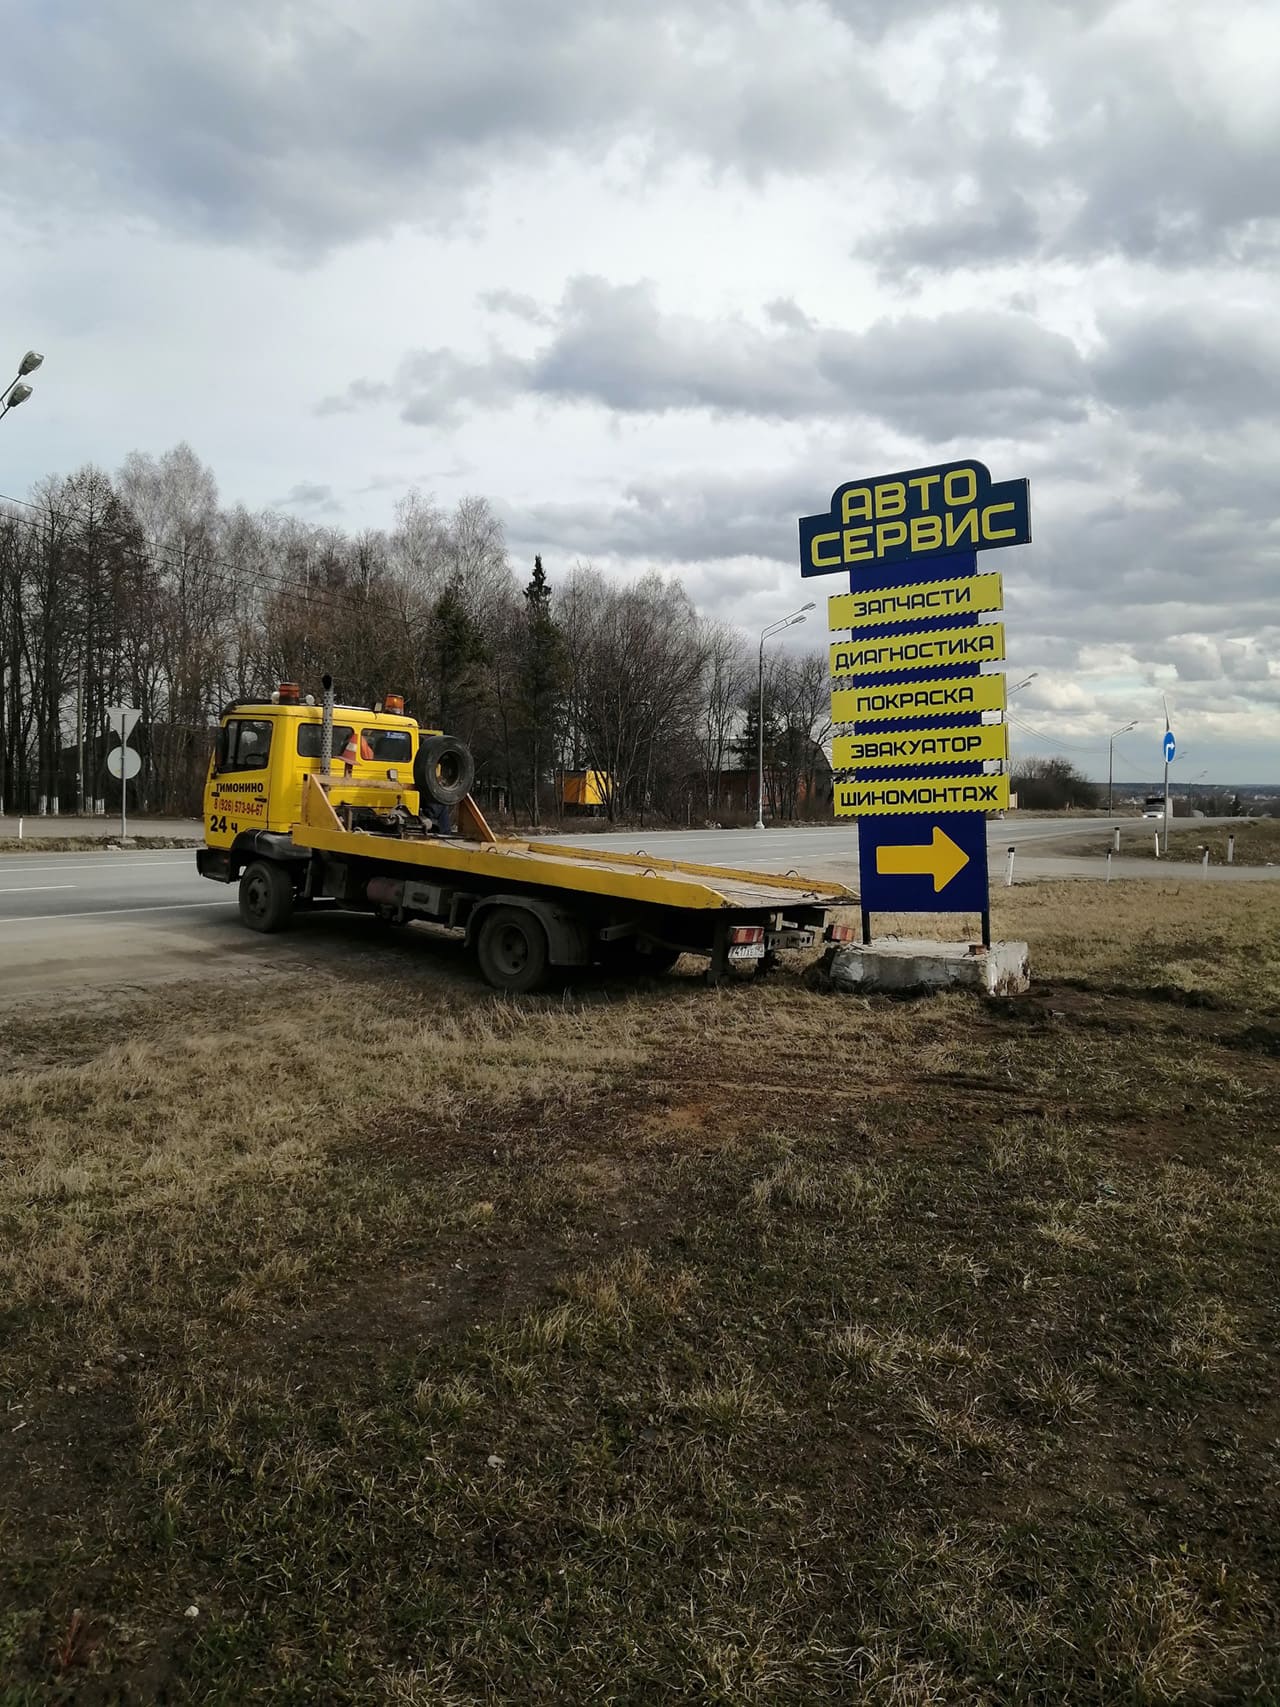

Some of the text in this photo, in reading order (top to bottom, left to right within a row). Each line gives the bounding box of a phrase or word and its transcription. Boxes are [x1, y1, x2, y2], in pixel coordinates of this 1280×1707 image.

[841, 468, 977, 524] АВТО
[811, 502, 1016, 567] СЕРВИС
[853, 587, 971, 617] ЗАПЧАСТИ
[835, 635, 994, 671] ДИАГНОСТИКА
[856, 687, 974, 712] ПОКРАСКА
[851, 735, 982, 759] ЭВАКУАТОР
[216, 783, 264, 793] ТИМОНИНО
[840, 785, 999, 807] ШИНОМОНТАЖ
[210, 815, 227, 833] 24
